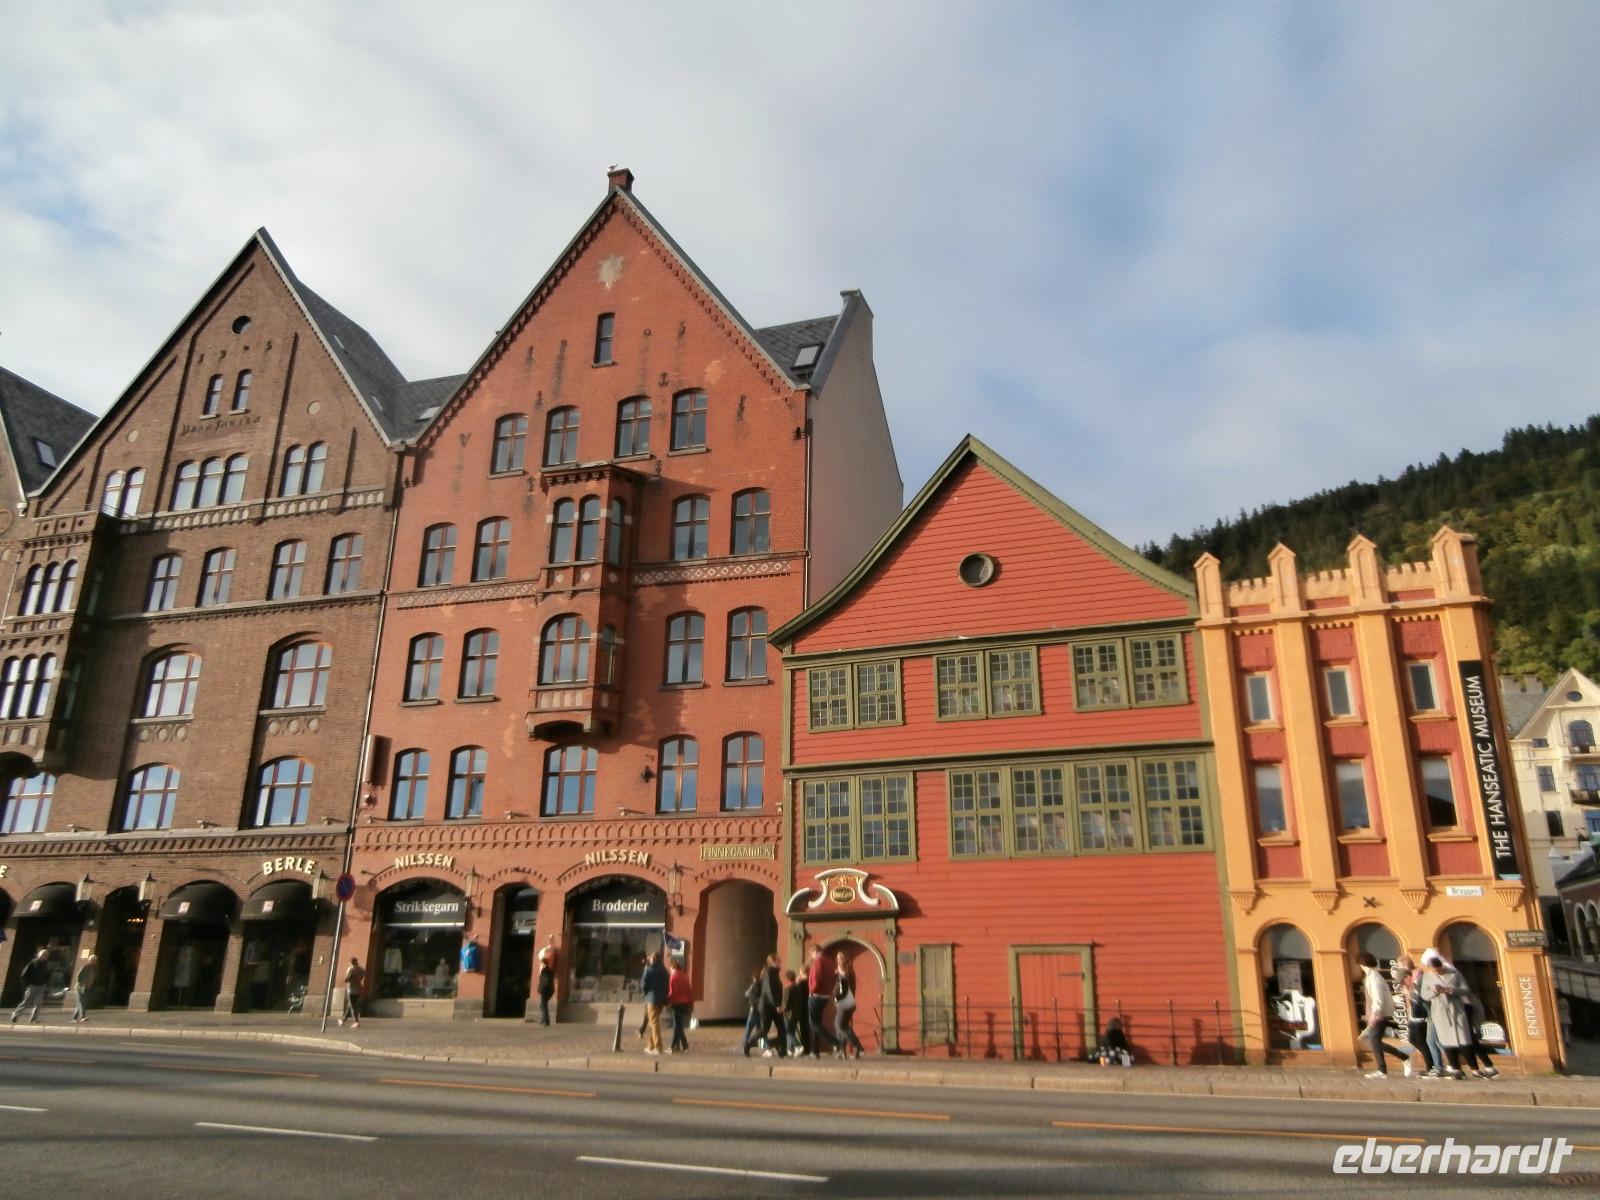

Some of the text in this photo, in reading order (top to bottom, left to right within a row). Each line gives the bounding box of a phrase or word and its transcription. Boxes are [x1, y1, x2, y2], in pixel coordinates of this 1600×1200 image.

[1466, 675, 1512, 859] THE HANSEATIC MUSEUM
[395, 852, 454, 869] NILSSEN
[585, 848, 649, 865] NILSSEN
[263, 856, 315, 876] BERLE
[394, 900, 459, 915] Strikkegarn
[592, 898, 650, 912] Broderier
[1519, 975, 1540, 1036] ENTRANCE
